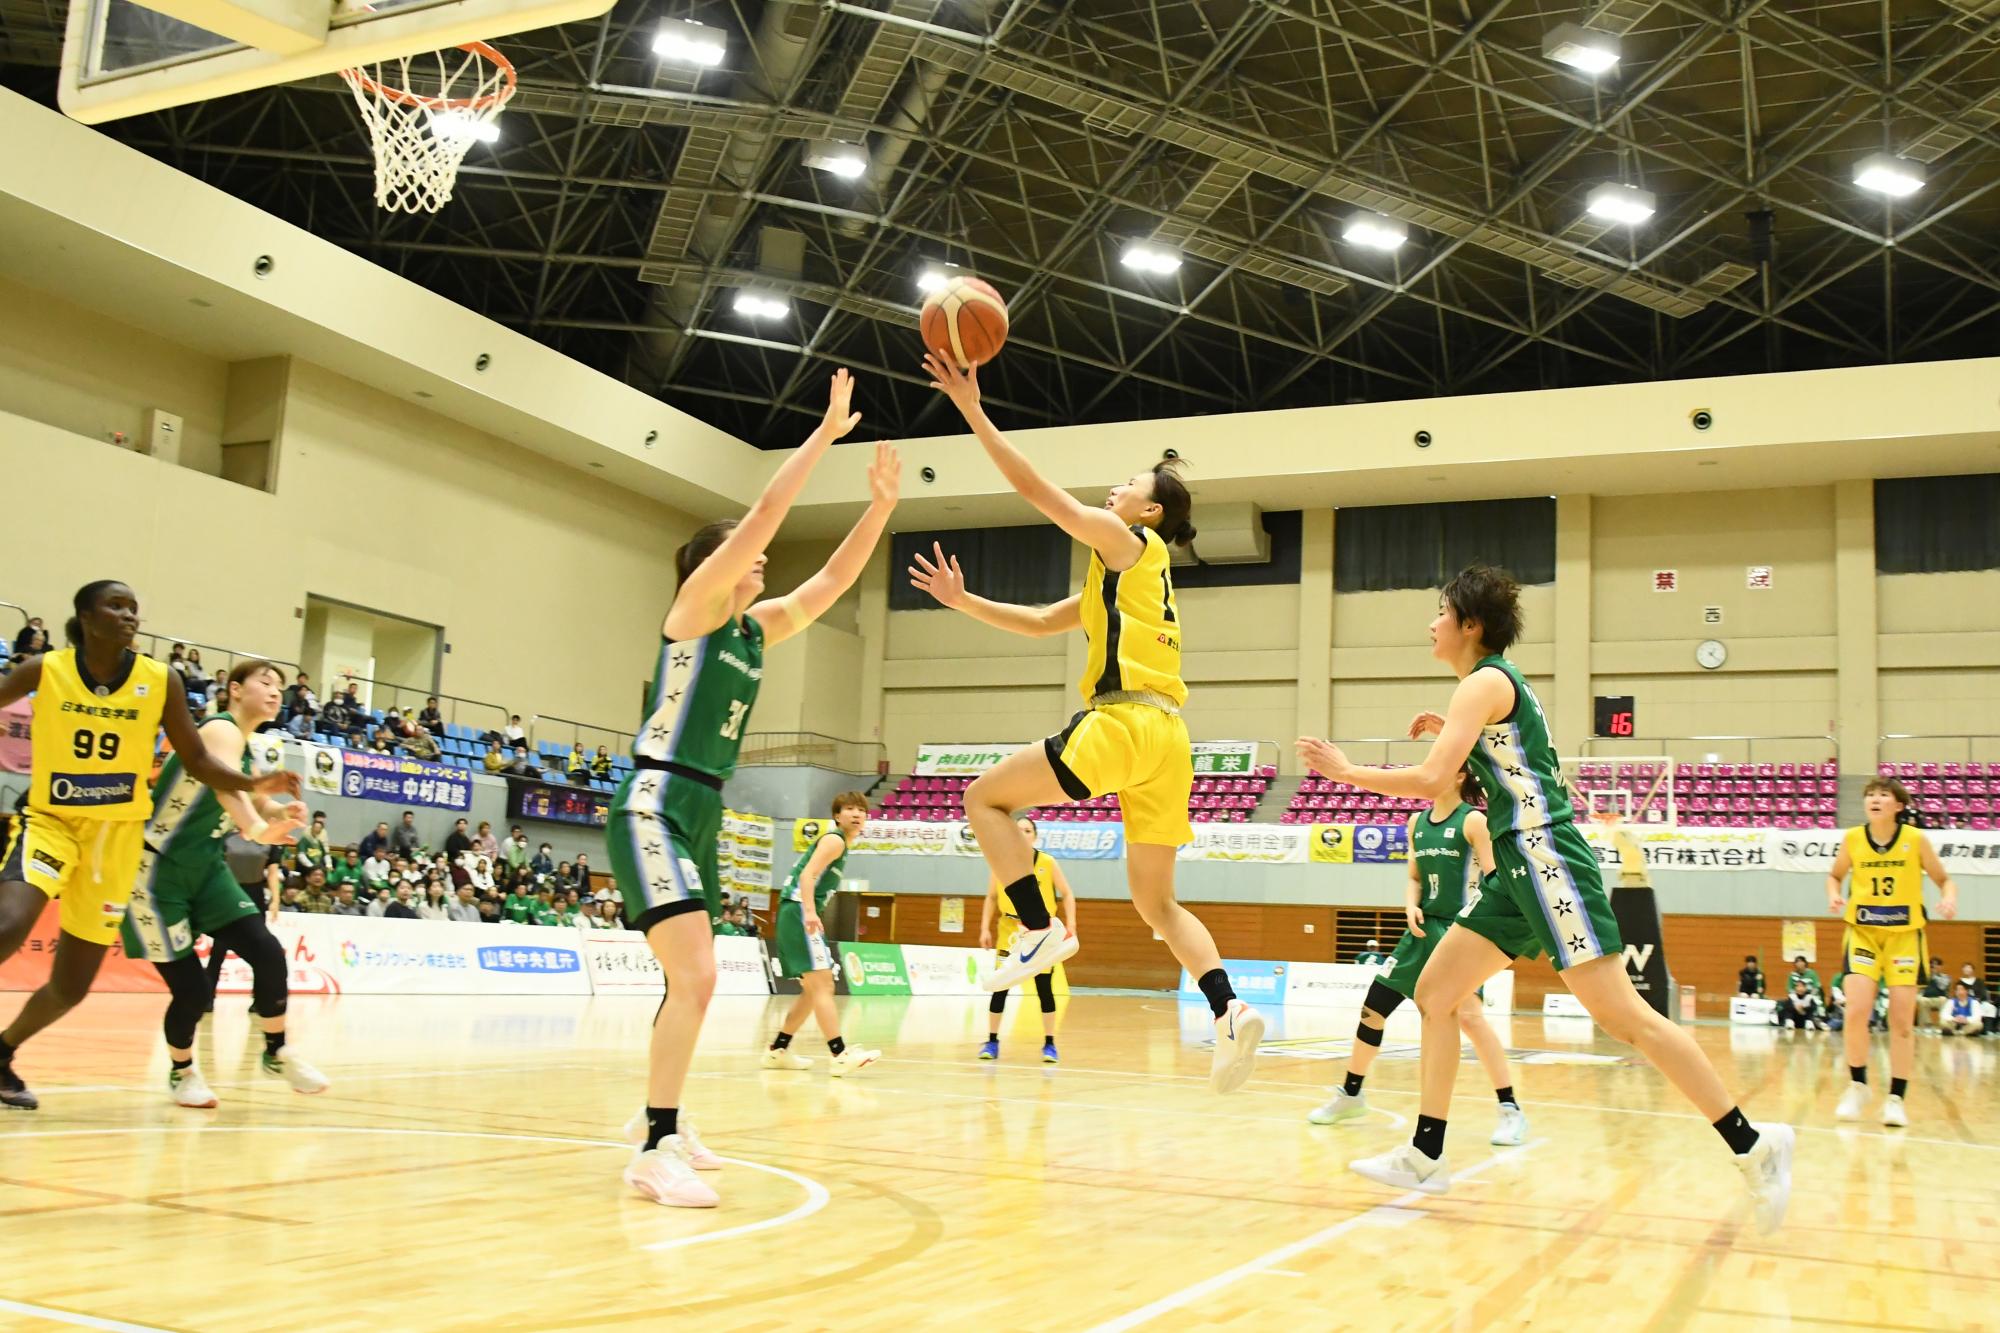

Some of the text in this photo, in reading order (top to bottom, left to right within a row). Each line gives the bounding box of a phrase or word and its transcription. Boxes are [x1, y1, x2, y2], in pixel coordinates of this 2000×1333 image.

[1655, 572, 1676, 590] 禁
[61, 701, 140, 721] 日本航空学園
[1611, 712, 1633, 736] 16
[73, 729, 121, 761] 99
[402, 777, 467, 807] 中村建設
[1191, 833, 1298, 851] 山梨信用金庫
[1871, 877, 1896, 898] 13
[482, 949, 575, 970] 山梨中央銀行
